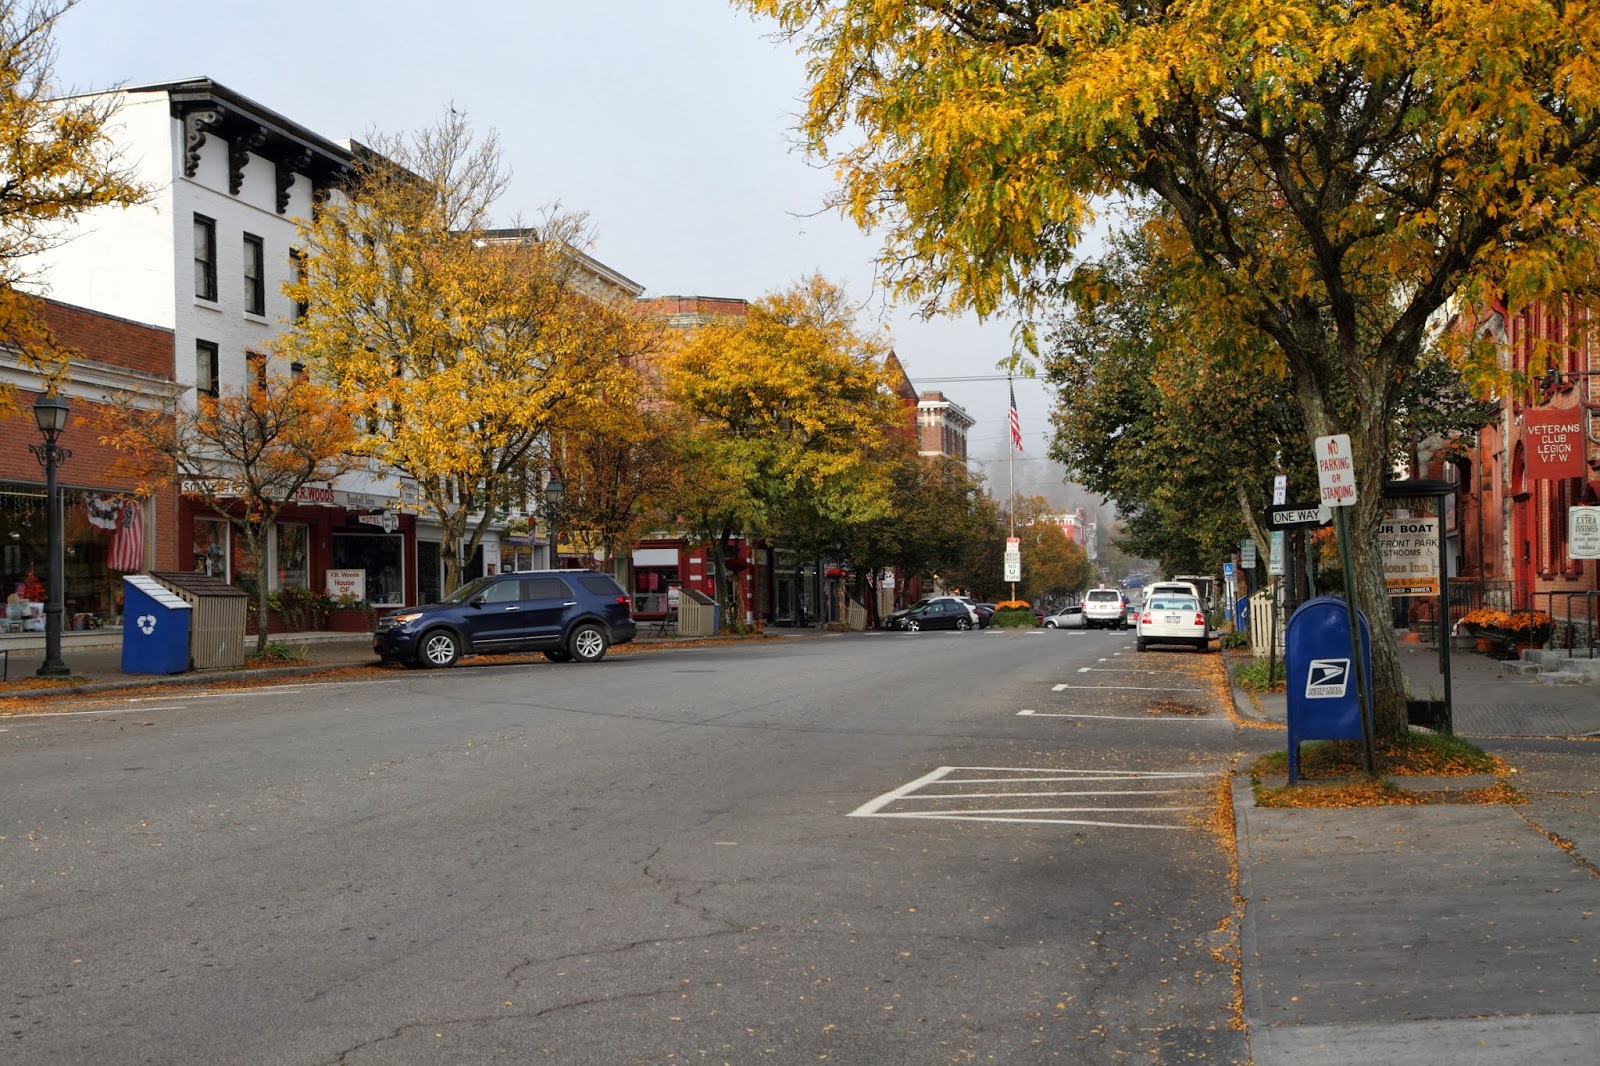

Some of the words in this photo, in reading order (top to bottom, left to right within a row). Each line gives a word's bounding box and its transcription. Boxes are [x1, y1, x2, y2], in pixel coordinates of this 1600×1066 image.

[1528, 424, 1580, 435] VETERANS
[1541, 434, 1567, 444] CLUB
[1327, 441, 1339, 455] NO
[1537, 444, 1572, 454] LEGION
[1320, 457, 1350, 472] PARKING
[1331, 473, 1342, 483] OR
[308, 488, 335, 502] WOODS
[1322, 484, 1354, 500] STANDING
[1408, 496, 1434, 512] LANE
[1274, 511, 1295, 523] ONE
[1298, 510, 1320, 521] WAY
[1576, 516, 1597, 525] EXTRA
[1378, 525, 1394, 534] UR
[1400, 524, 1434, 533] BOAT
[1575, 524, 1599, 533] INNINGS
[1380, 539, 1411, 549] FRONT
[1414, 538, 1439, 547] PARK
[1380, 549, 1421, 557] ESTROOMS
[1383, 562, 1407, 574] ions
[1408, 561, 1430, 573] Inn
[1384, 579, 1400, 587] teak
[1408, 578, 1435, 586] Seafood
